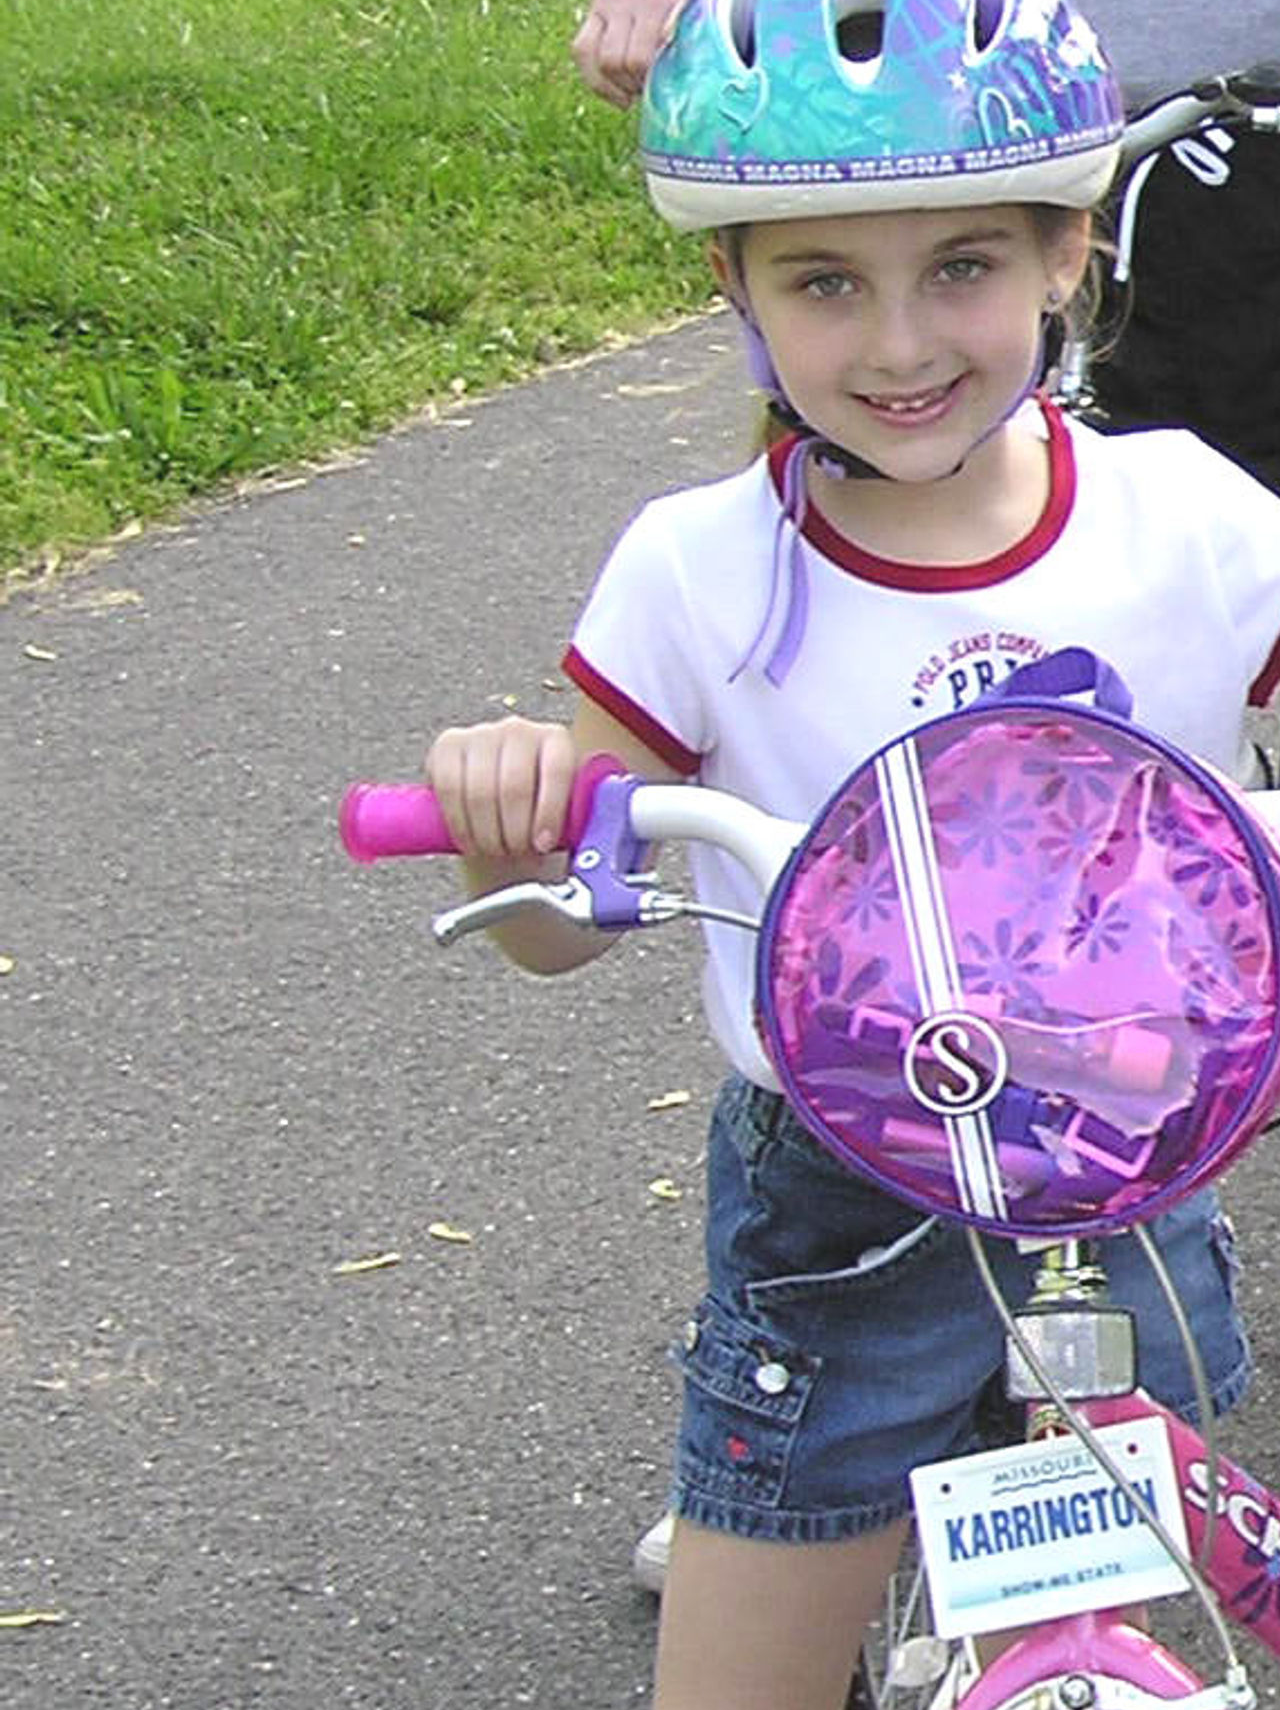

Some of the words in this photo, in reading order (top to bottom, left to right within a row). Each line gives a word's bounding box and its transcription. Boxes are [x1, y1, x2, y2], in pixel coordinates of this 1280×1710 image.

[743, 162, 842, 183] MAGNA
[850, 153, 956, 178] MAGNA
[966, 140, 1050, 169] MAGNA
[992, 1454, 1094, 1485] MISSOURI
[945, 1478, 1160, 1563] KARRINGTON
